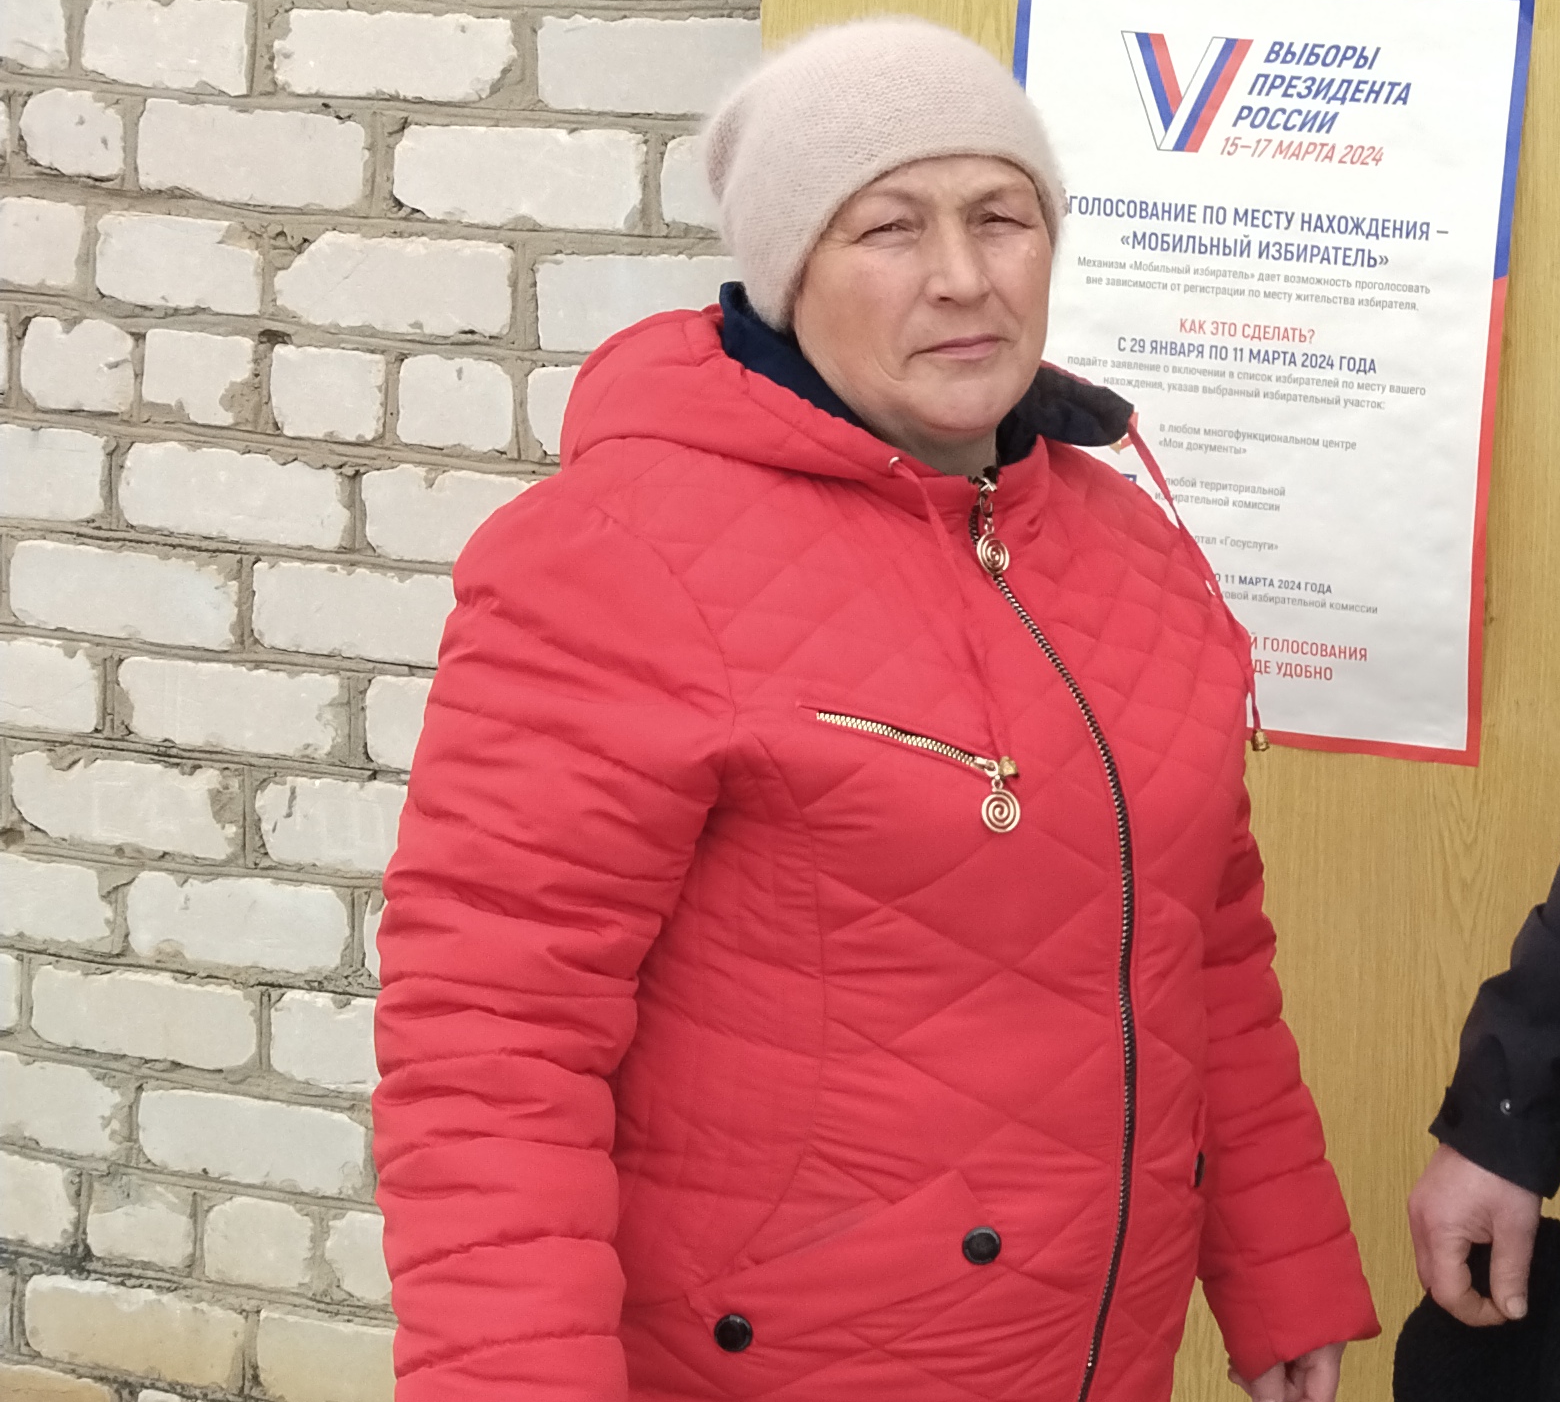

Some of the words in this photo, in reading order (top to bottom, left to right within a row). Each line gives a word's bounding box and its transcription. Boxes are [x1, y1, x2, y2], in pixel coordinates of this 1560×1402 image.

[1263, 40, 1382, 71] ВЫБОРЫ
[1247, 73, 1412, 106] ПРЕЗИДЕНТА
[1231, 105, 1340, 135] РОССИИ
[1271, 141, 1336, 164] МАРТА
[1337, 144, 1384, 167] 2024
[1068, 195, 1198, 224] ГОЛОСОВАНИЕ
[1202, 205, 1227, 225] ПО
[1232, 207, 1295, 231] МЕСТУ
[1299, 212, 1431, 241] НАХОЖДЕНИЯ
[1120, 229, 1252, 259] «МОБИЛЬНЫЙ
[1257, 239, 1389, 269] ИЗБИРАТЕЛЬ»
[1077, 256, 1126, 270] Механизм
[1193, 266, 1255, 281] избиратель»
[1257, 272, 1281, 283] дает
[1283, 274, 1352, 288] возможность
[1355, 279, 1431, 295] проголосовать
[1085, 275, 1103, 286] вне
[1105, 277, 1168, 291] зависимости
[1170, 282, 1181, 292] от
[1183, 283, 1246, 299] регистрации
[1248, 288, 1261, 299] по
[1263, 289, 1293, 303] месту
[1295, 292, 1356, 306] жительства
[1357, 296, 1419, 312] избирателя.
[1179, 317, 1206, 335] КАК
[1210, 320, 1237, 337] ЭТО
[1241, 323, 1316, 345] СДЕЛАТЬ?
[1117, 336, 1127, 352] С
[1130, 337, 1146, 354] 29
[1149, 339, 1205, 359] ЯНВАРЯ
[1209, 344, 1229, 361] ПО
[1232, 346, 1244, 362] 11
[1248, 348, 1298, 367] МАРТА
[1301, 352, 1335, 371] 2024
[1338, 355, 1377, 375] ГОДА
[1067, 355, 1108, 368] подайте
[1110, 360, 1161, 372] заявление
[1163, 365, 1169, 373] о
[1171, 365, 1226, 378] включении
[1228, 370, 1235, 379] в
[1237, 371, 1273, 383] список
[1275, 374, 1340, 389] избирателей
[1342, 380, 1354, 390] по
[1356, 382, 1387, 395] месту
[1389, 384, 1426, 396] вашего
[1167, 381, 1200, 394] указав
[1202, 383, 1260, 398] выбранный
[1263, 389, 1341, 406] избирательный
[1167, 423, 1200, 435] любом
[1203, 427, 1320, 447] многофункциональном
[1322, 438, 1357, 452] центре
[1186, 441, 1247, 455] документы»
[1199, 480, 1286, 497] территориальной
[1232, 499, 1280, 512] комиссии
[1224, 573, 1236, 584] 11
[1238, 574, 1275, 589] МАРТА
[1277, 578, 1302, 591] 2024
[1304, 581, 1333, 595] ГОДА
[1251, 590, 1327, 609] избирательной
[1329, 600, 1378, 615] комиссии
[1262, 636, 1368, 663] ГОЛОСОВАНИЯ
[1275, 661, 1334, 682] УДОБНО
